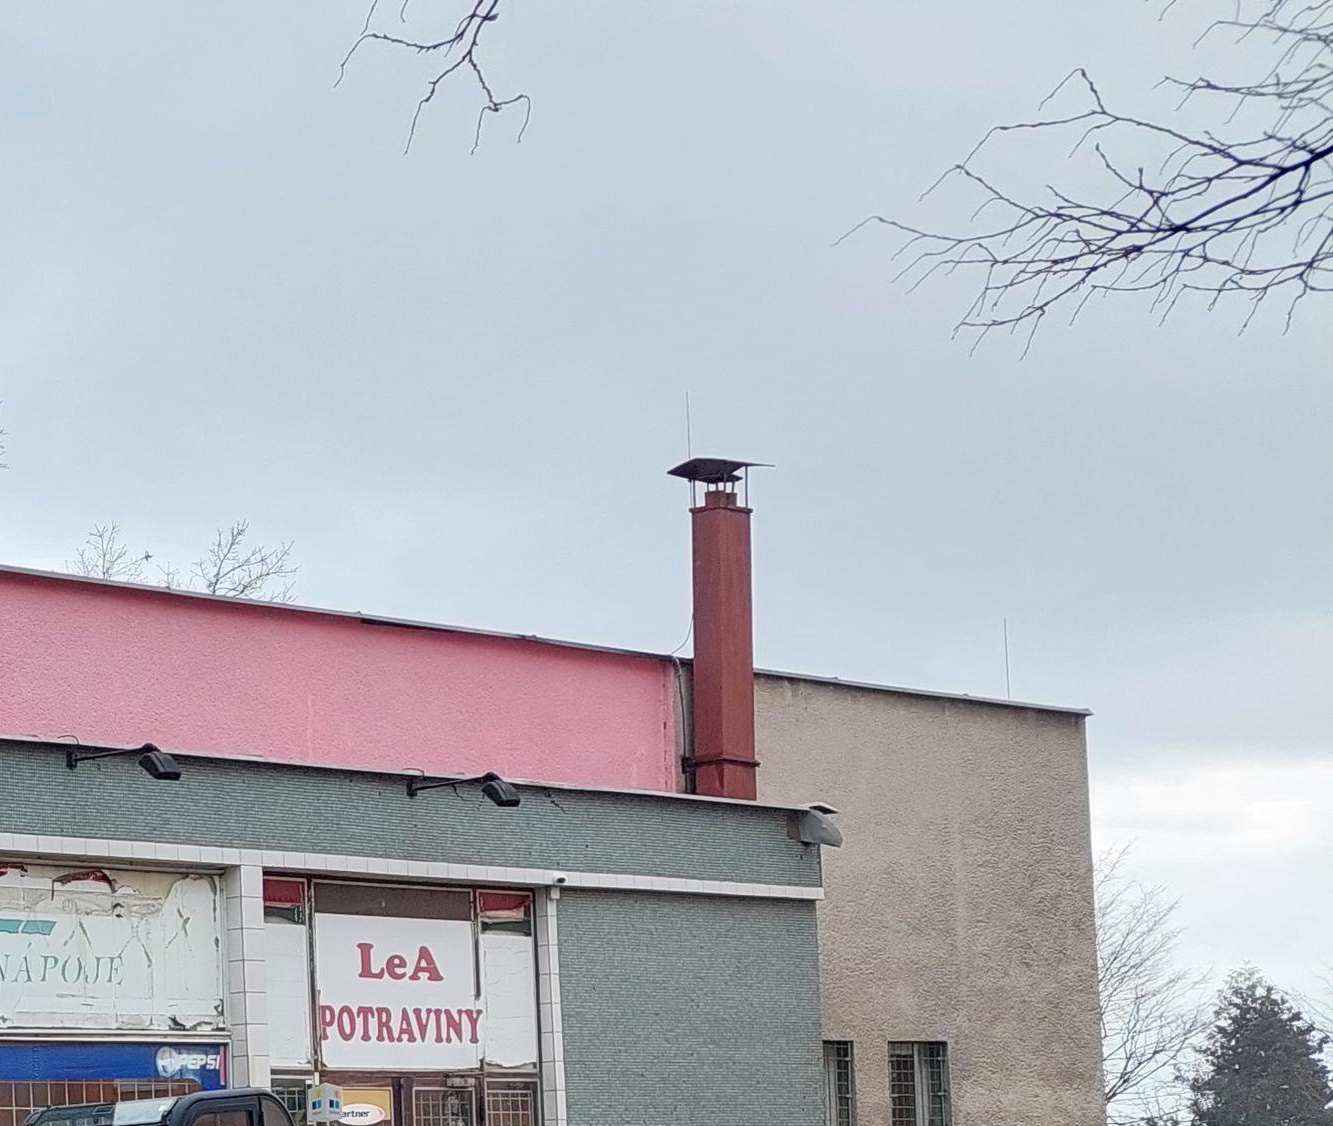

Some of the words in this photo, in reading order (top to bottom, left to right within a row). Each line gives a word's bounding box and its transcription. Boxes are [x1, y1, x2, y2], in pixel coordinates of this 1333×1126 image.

[357, 943, 444, 981] LeA
[321, 1004, 483, 1044] POTRAVINY
[177, 1052, 221, 1070] PEPSI
[341, 1110, 370, 1118] artner
